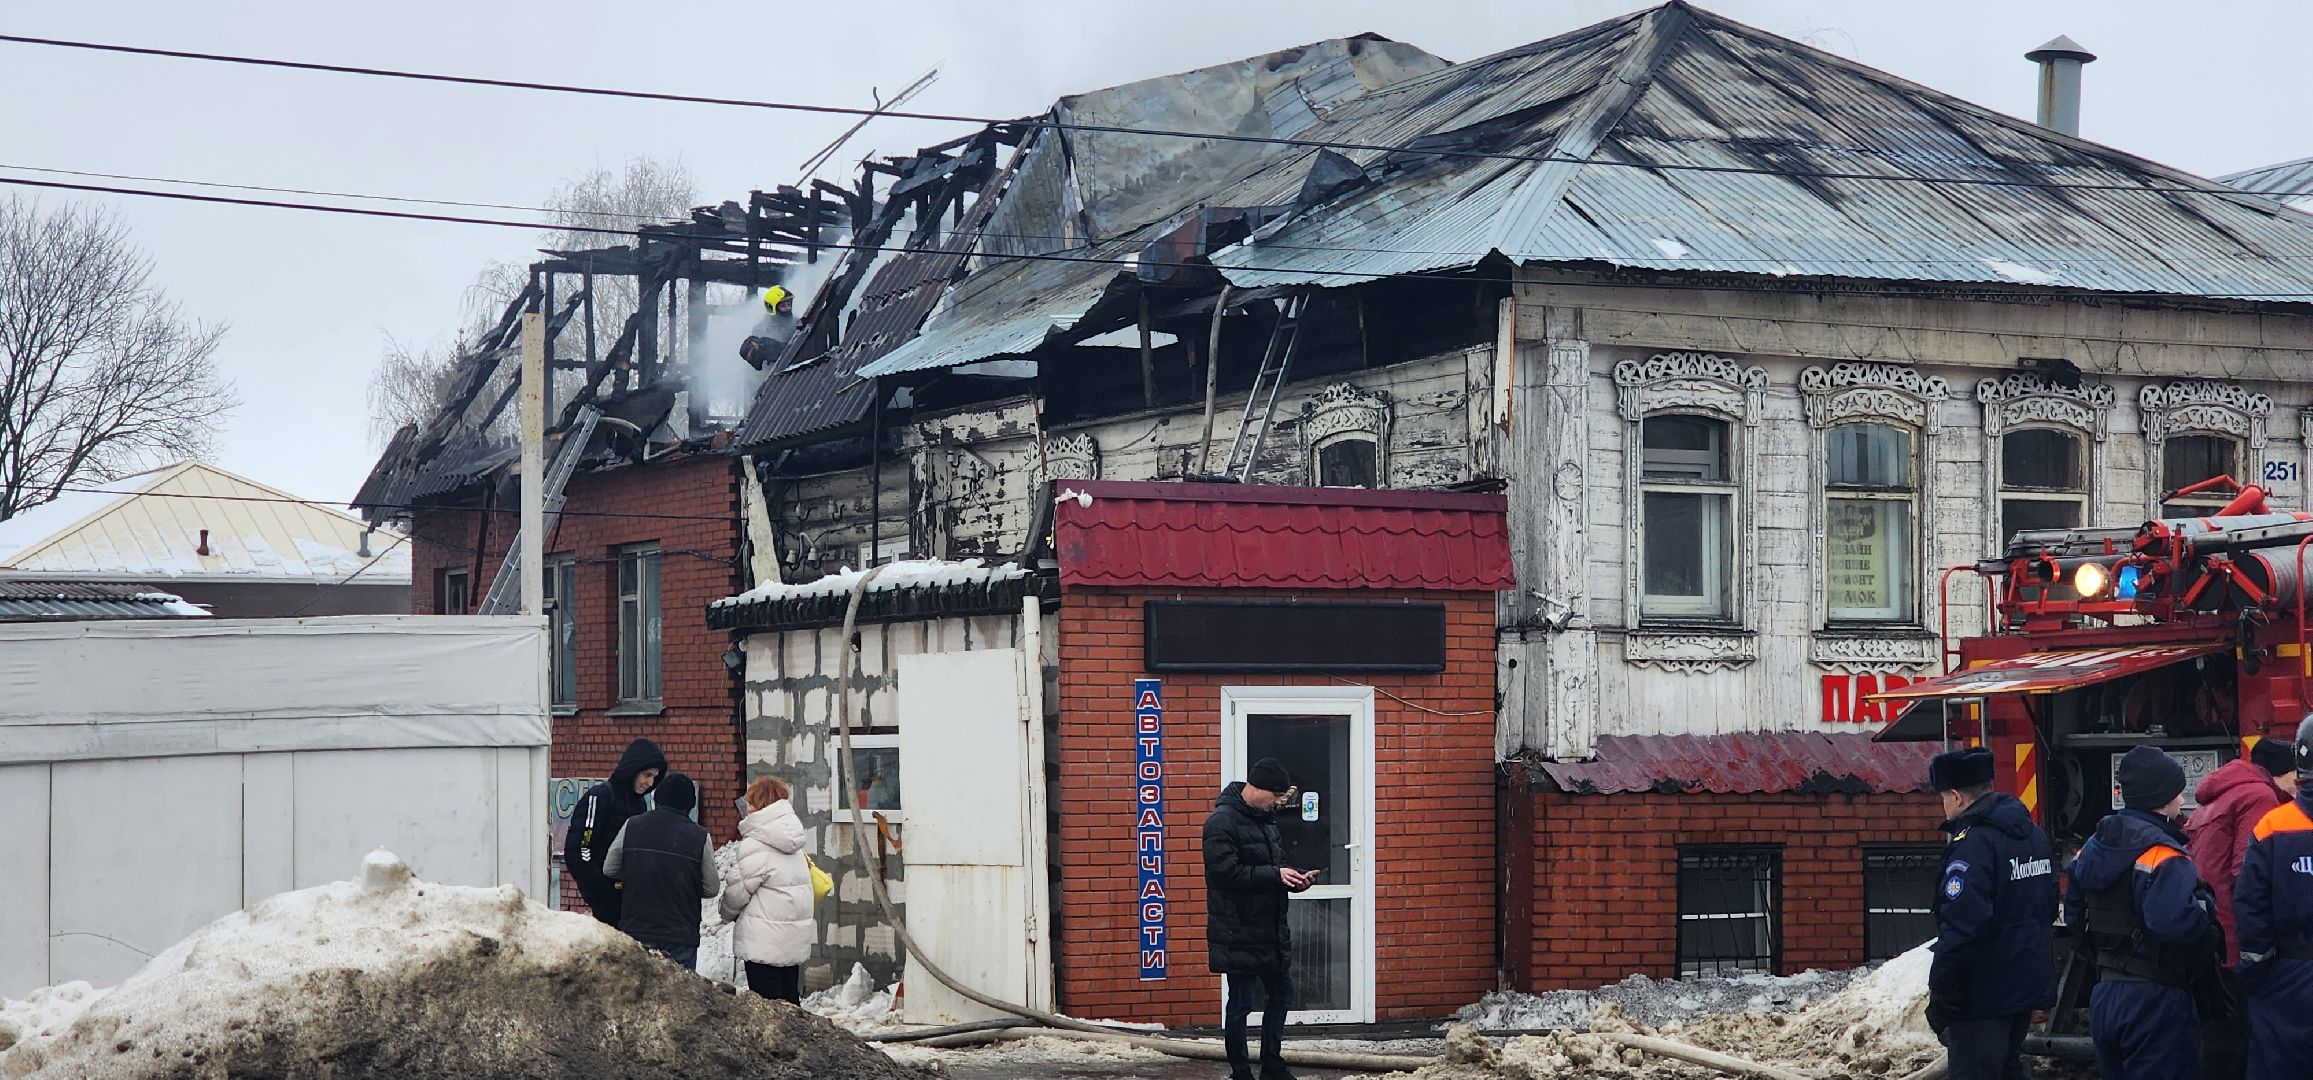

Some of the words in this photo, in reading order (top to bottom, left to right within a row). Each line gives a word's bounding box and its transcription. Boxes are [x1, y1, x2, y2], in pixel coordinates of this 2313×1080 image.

[2266, 461, 2297, 481] 251
[1822, 674, 1945, 723] ПАР
[1138, 690, 1165, 970] АВТОЗАПЧАСТИ
